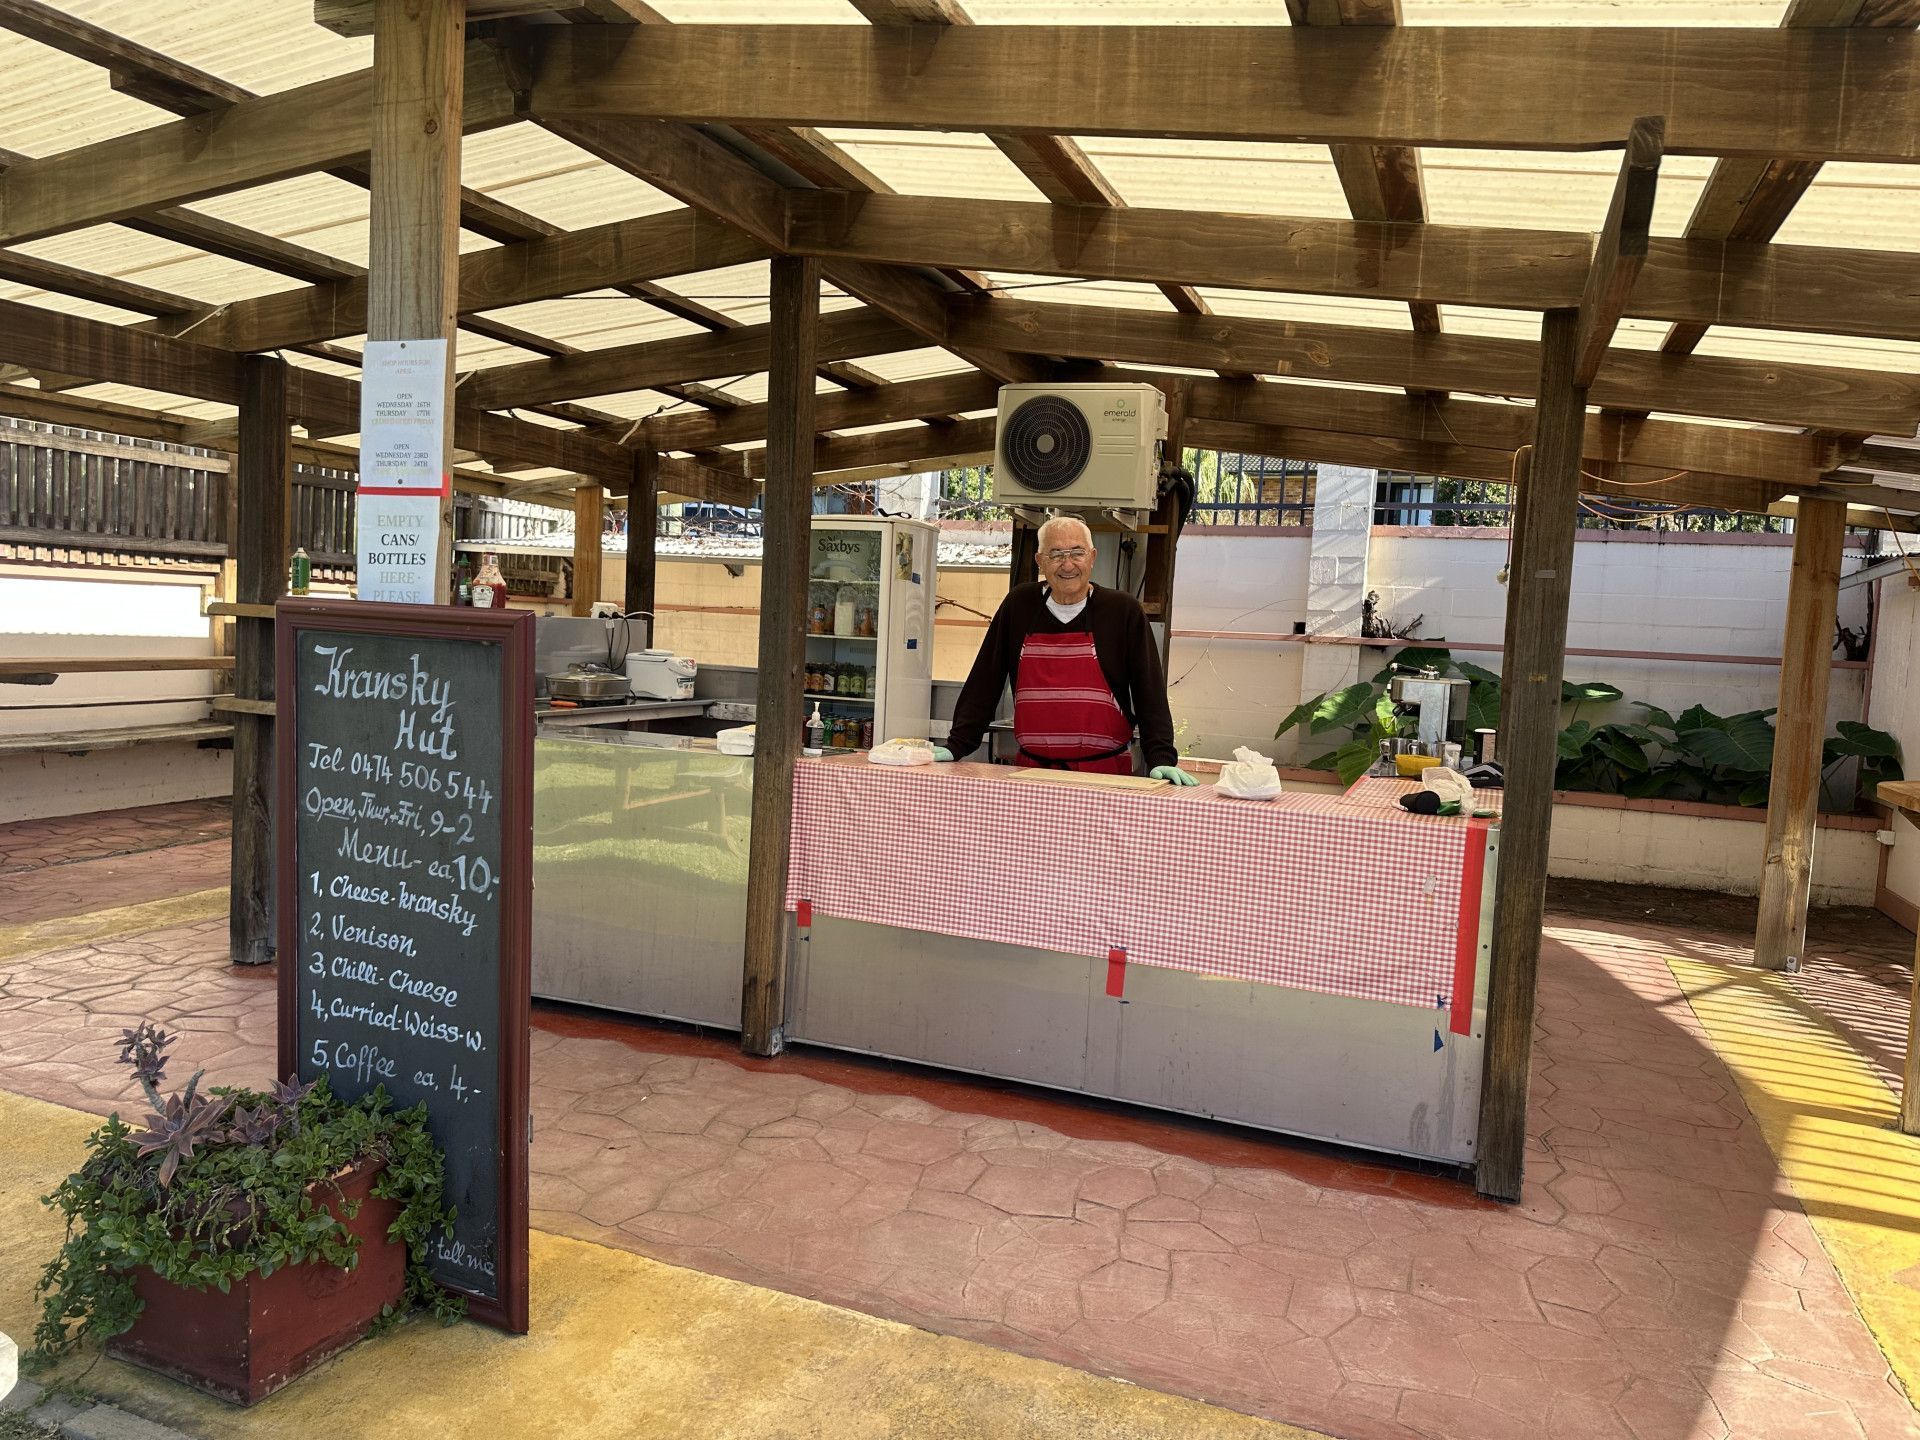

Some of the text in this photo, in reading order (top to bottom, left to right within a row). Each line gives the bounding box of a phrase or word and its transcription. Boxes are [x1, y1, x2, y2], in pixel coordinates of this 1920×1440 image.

[1103, 409, 1137, 417] emerald
[377, 514, 424, 527] EMPTY
[381, 532, 420, 546] CANS/
[818, 538, 861, 554] Saxbys
[368, 552, 427, 566] BOTTLES
[373, 590, 421, 603] PLEASE
[314, 645, 456, 723] Kransky
[393, 709, 457, 760] Hut
[308, 742, 493, 814] Tel. 0474 506 544
[335, 1042, 399, 1083] Coffee
